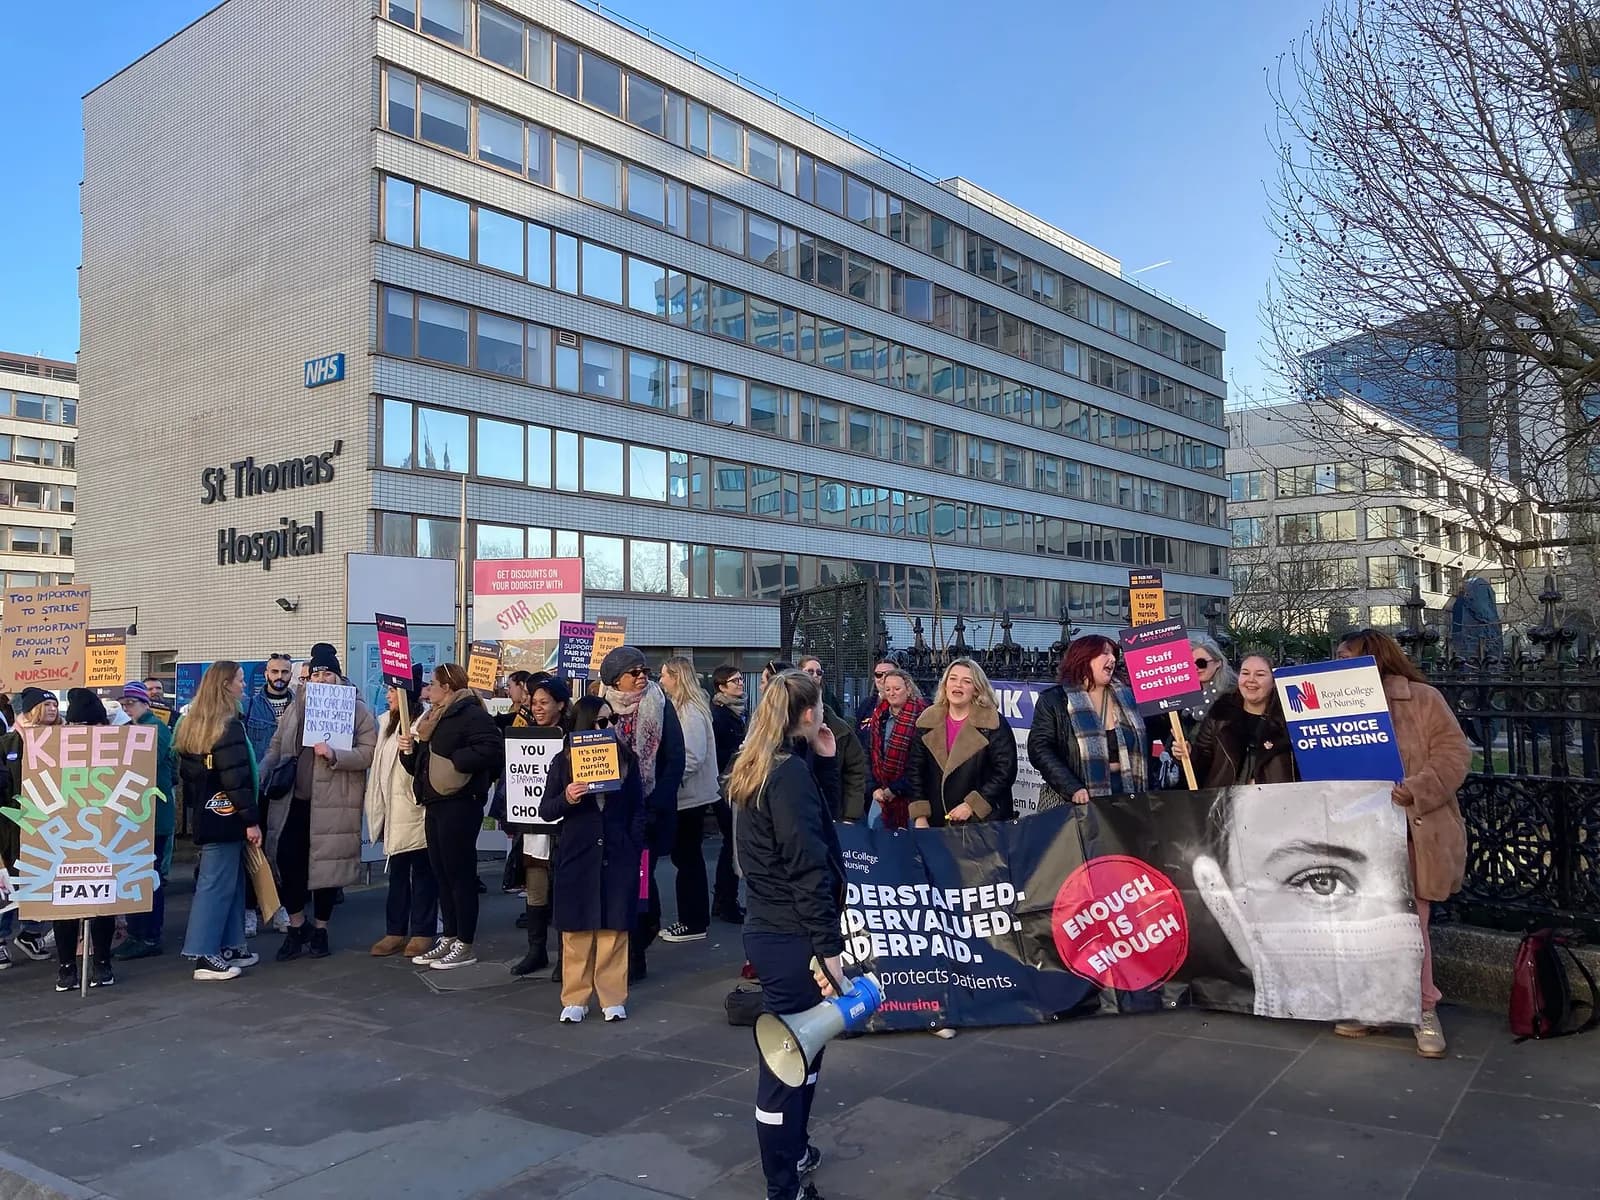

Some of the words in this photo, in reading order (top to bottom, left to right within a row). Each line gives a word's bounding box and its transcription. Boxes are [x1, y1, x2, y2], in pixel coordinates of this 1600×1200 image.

[306, 355, 338, 385] NHS
[201, 467, 227, 504] St
[217, 511, 324, 571] Hospital
[497, 570, 509, 579] GET
[511, 569, 547, 578] DISCOUNTS
[549, 569, 558, 578] ON
[492, 581, 509, 590] YOUR
[511, 581, 545, 590] DOORSTEP
[546, 580, 563, 589] WITH
[10, 593, 33, 603] TOO
[37, 590, 90, 602] IMPORTANT
[22, 608, 35, 616] TO
[41, 603, 80, 615] STRIKE
[496, 600, 532, 630] STAR
[523, 602, 558, 634] CARD
[4, 625, 23, 633] NOT
[27, 622, 86, 633] IMPORTANT
[563, 626, 595, 637] HONK
[1155, 625, 1181, 635] STAFFING
[15, 638, 53, 646] ENOUGH
[56, 636, 70, 644] TO
[387, 640, 400, 648] Staff
[12, 648, 30, 658] PAY
[35, 646, 69, 657] FAIRLY
[382, 648, 408, 660] shortages
[1145, 651, 1173, 665] Staff
[92, 665, 118, 673] nursing
[395, 660, 408, 669] lives
[1135, 661, 1189, 680] shortages
[104, 673, 122, 681] fairly
[1140, 678, 1163, 691] cost
[1165, 673, 1190, 686] lives
[329, 686, 341, 697] DO
[342, 687, 356, 699] YOU
[1321, 689, 1343, 699] Royal
[1345, 687, 1374, 696] College
[1334, 698, 1366, 708] Nursing
[306, 720, 317, 732] ON
[1299, 724, 1330, 736] THE
[1331, 719, 1379, 734] VOICE
[25, 725, 155, 769] KEEP
[1297, 738, 1317, 750] OF
[1321, 732, 1389, 748] NURSING
[520, 745, 545, 756] YOU
[510, 764, 540, 774] GAVE
[580, 762, 610, 770] nursing
[0, 767, 167, 835] NURSES
[852, 851, 879, 864] College
[59, 865, 112, 874] IMPROVE
[60, 884, 110, 899] PAY!
[846, 882, 1026, 912] DERSTAFFED.
[1062, 874, 1155, 940] ENOUGH
[1107, 914, 1133, 938] IS
[840, 933, 983, 967] NDERPAID.
[1087, 913, 1181, 974] ENOUGH
[880, 967, 949, 989] protects
